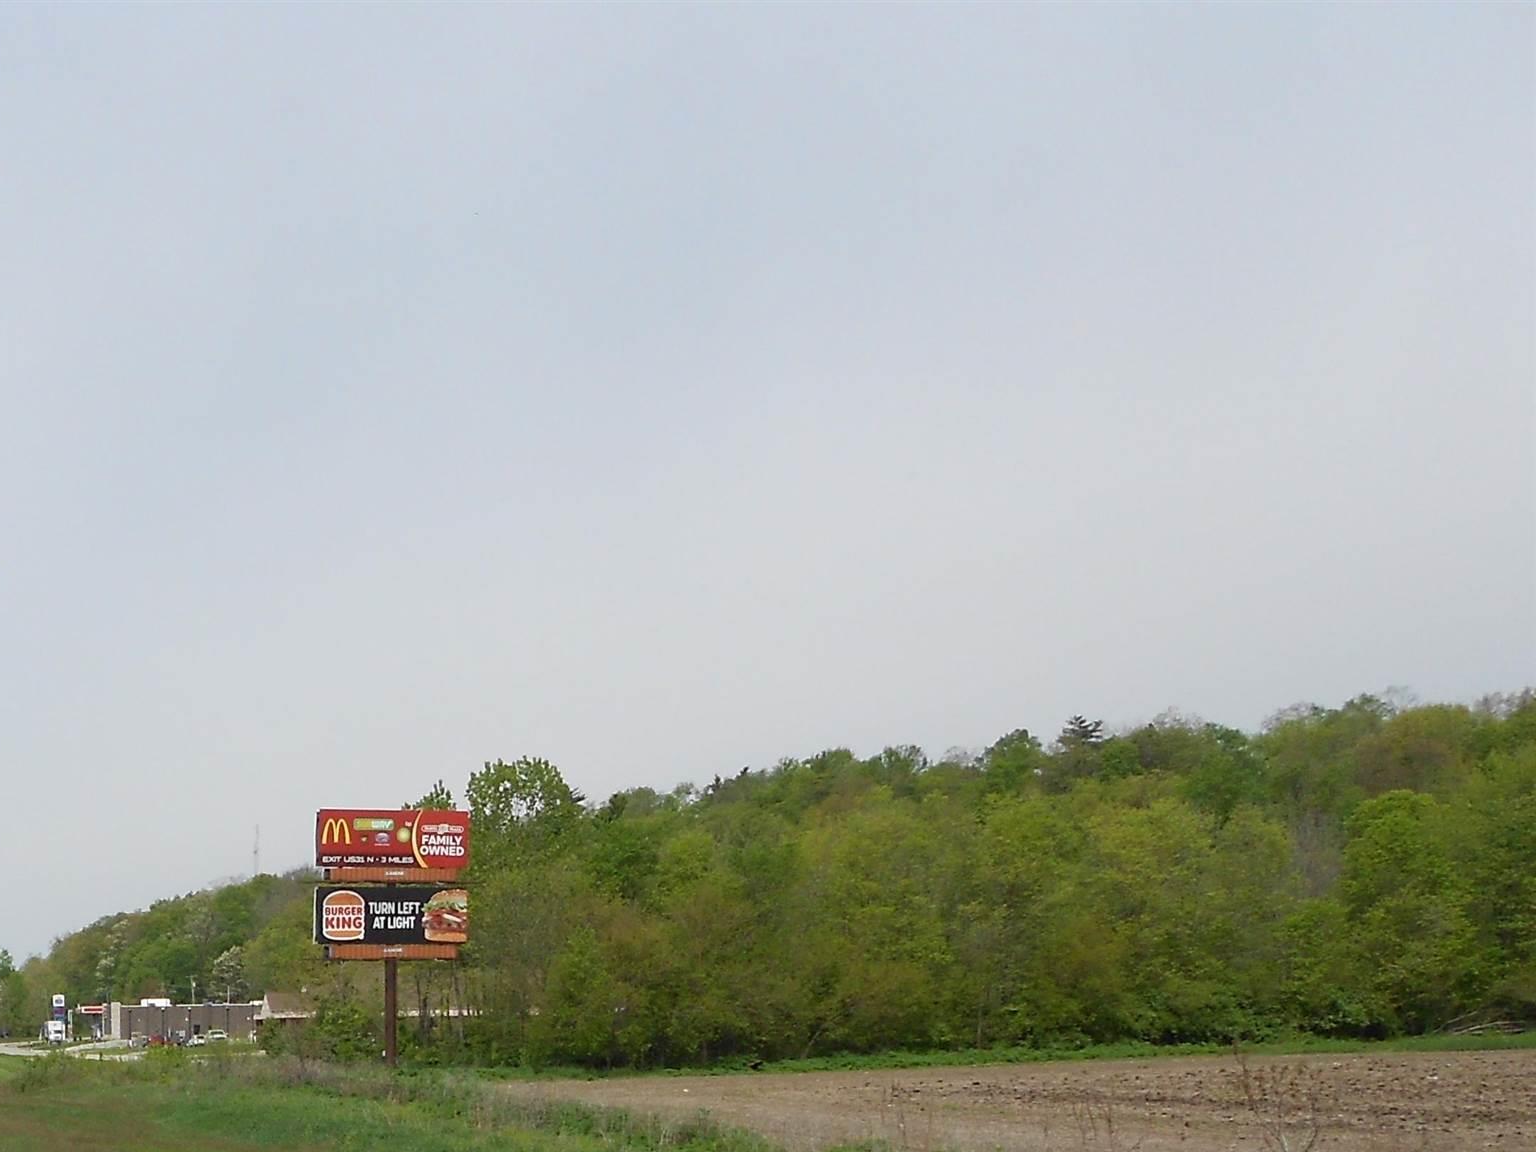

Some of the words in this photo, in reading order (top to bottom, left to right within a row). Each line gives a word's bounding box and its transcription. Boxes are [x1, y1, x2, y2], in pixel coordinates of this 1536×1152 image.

[421, 834, 463, 845] FAMILY
[419, 845, 465, 857] OWNED
[388, 856, 414, 864] MILES
[324, 906, 363, 916] BURGER
[368, 902, 396, 915] TURN
[397, 902, 421, 914] LEFT
[324, 916, 363, 930] KING
[372, 917, 387, 929] AT
[387, 916, 416, 929] LIGHT
